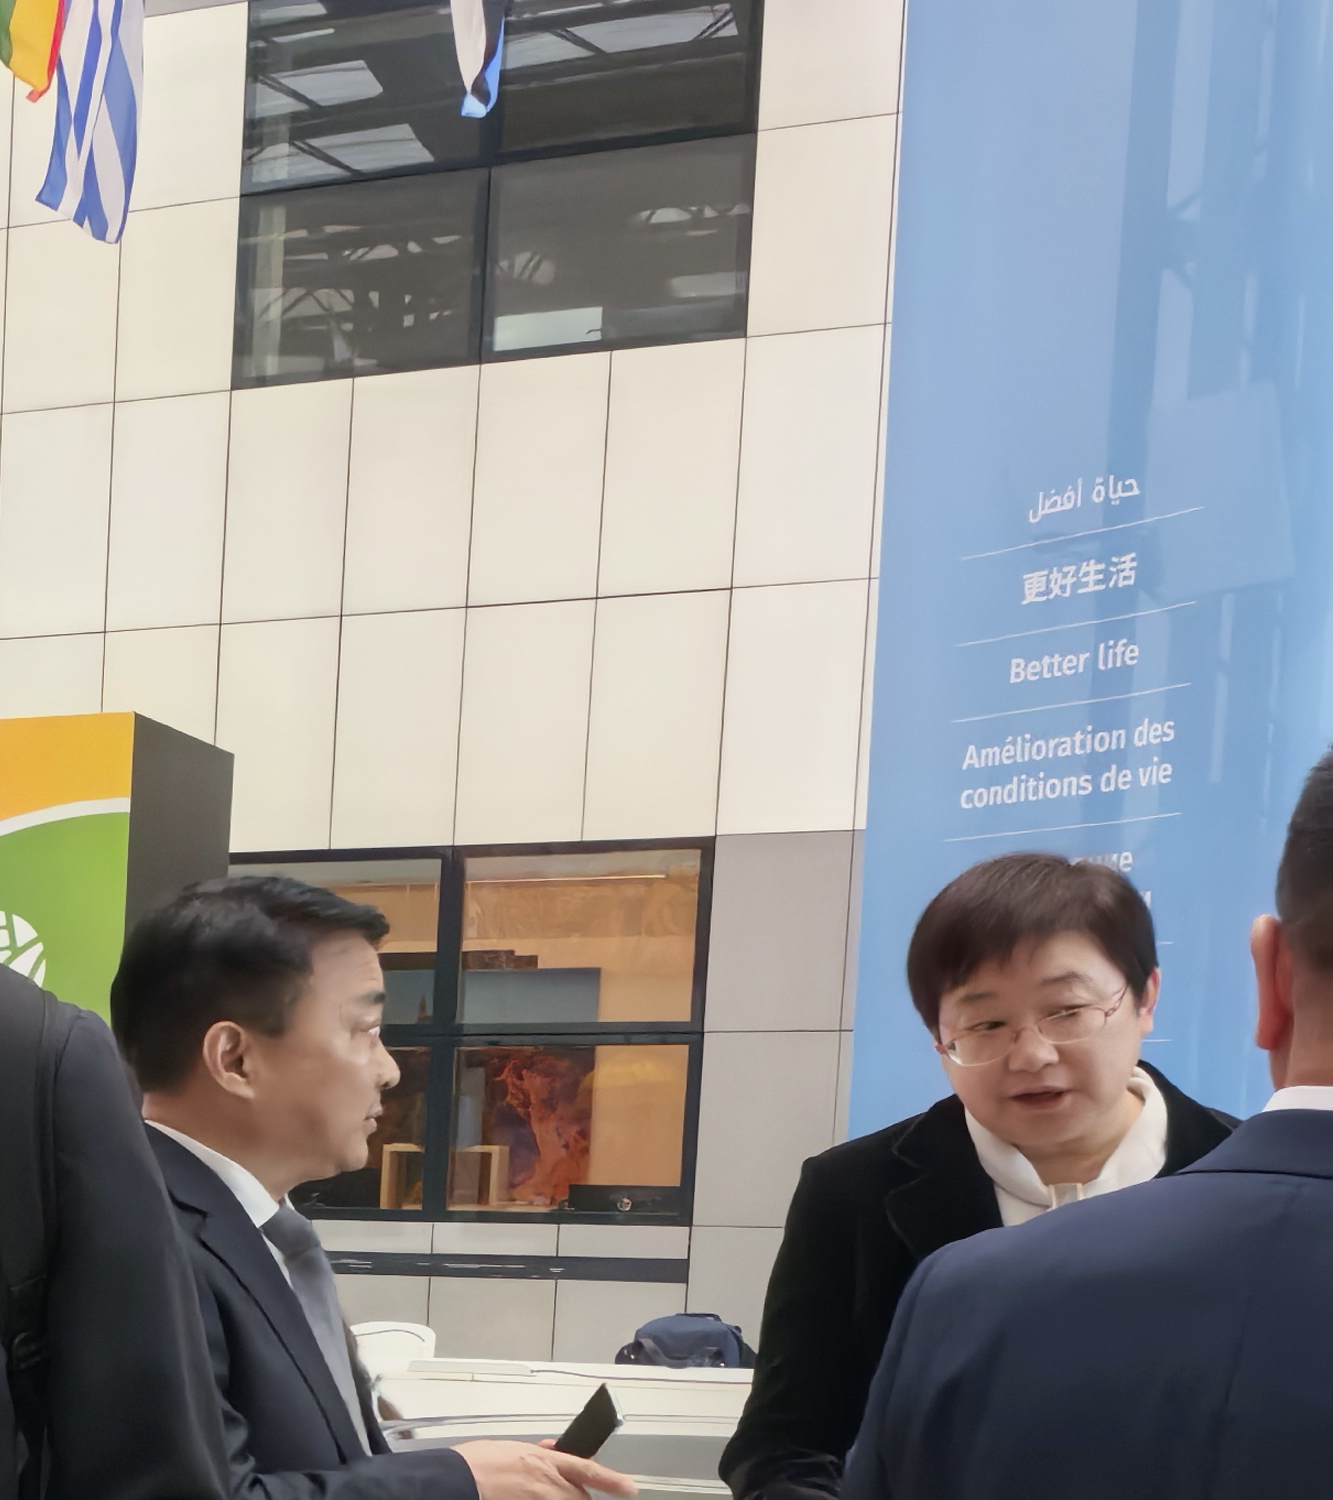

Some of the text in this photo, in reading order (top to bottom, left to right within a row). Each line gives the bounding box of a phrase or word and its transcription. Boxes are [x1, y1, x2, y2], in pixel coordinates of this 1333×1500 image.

[1091, 474, 1141, 505] حياة
[1021, 552, 1138, 605] 更好生活
[1009, 638, 1140, 684] Better life
[961, 717, 1175, 771] Amélioration des
[960, 756, 1173, 809] conditions de vie
